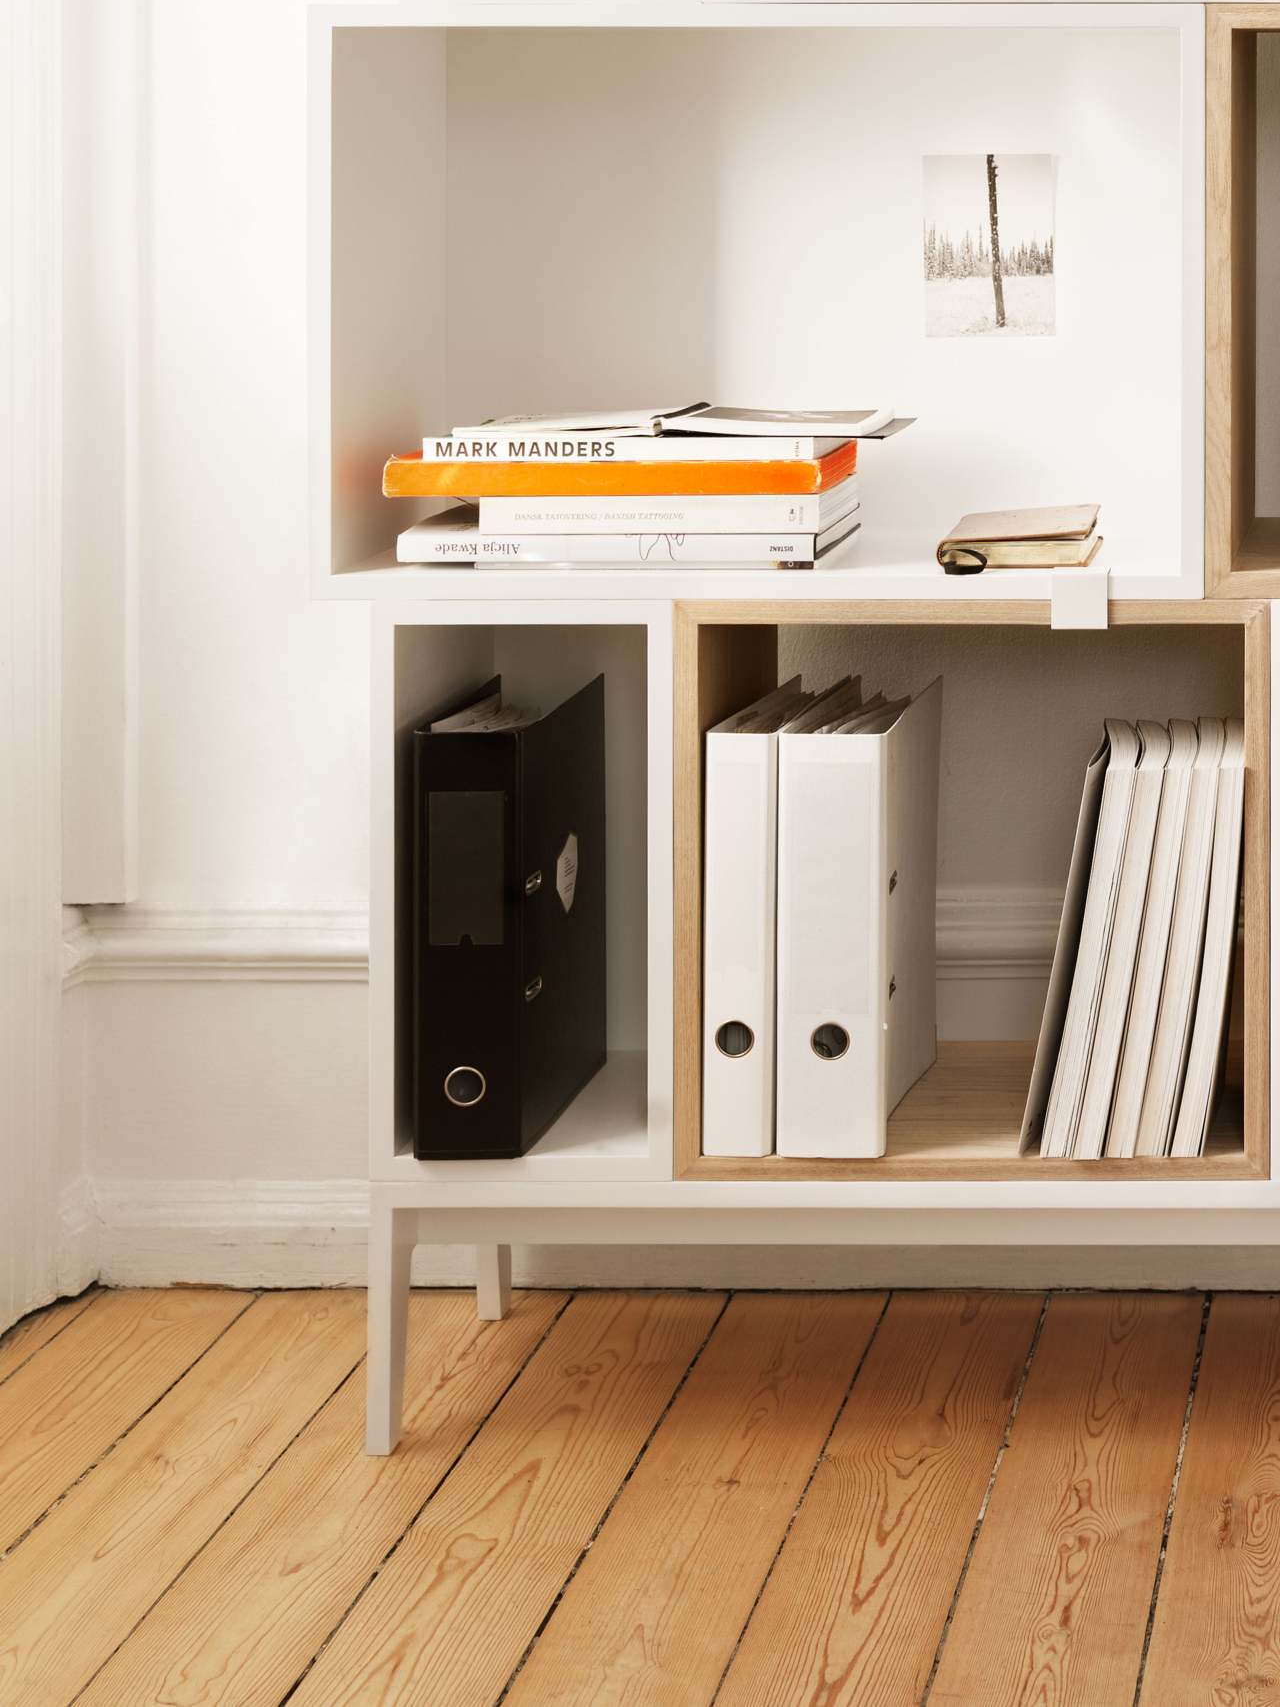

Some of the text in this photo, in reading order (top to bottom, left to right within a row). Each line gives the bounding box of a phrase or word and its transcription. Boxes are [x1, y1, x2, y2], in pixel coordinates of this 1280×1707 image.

[435, 442, 615, 457] MARK MANDERS
[434, 543, 521, 555] Alicja Kwade
